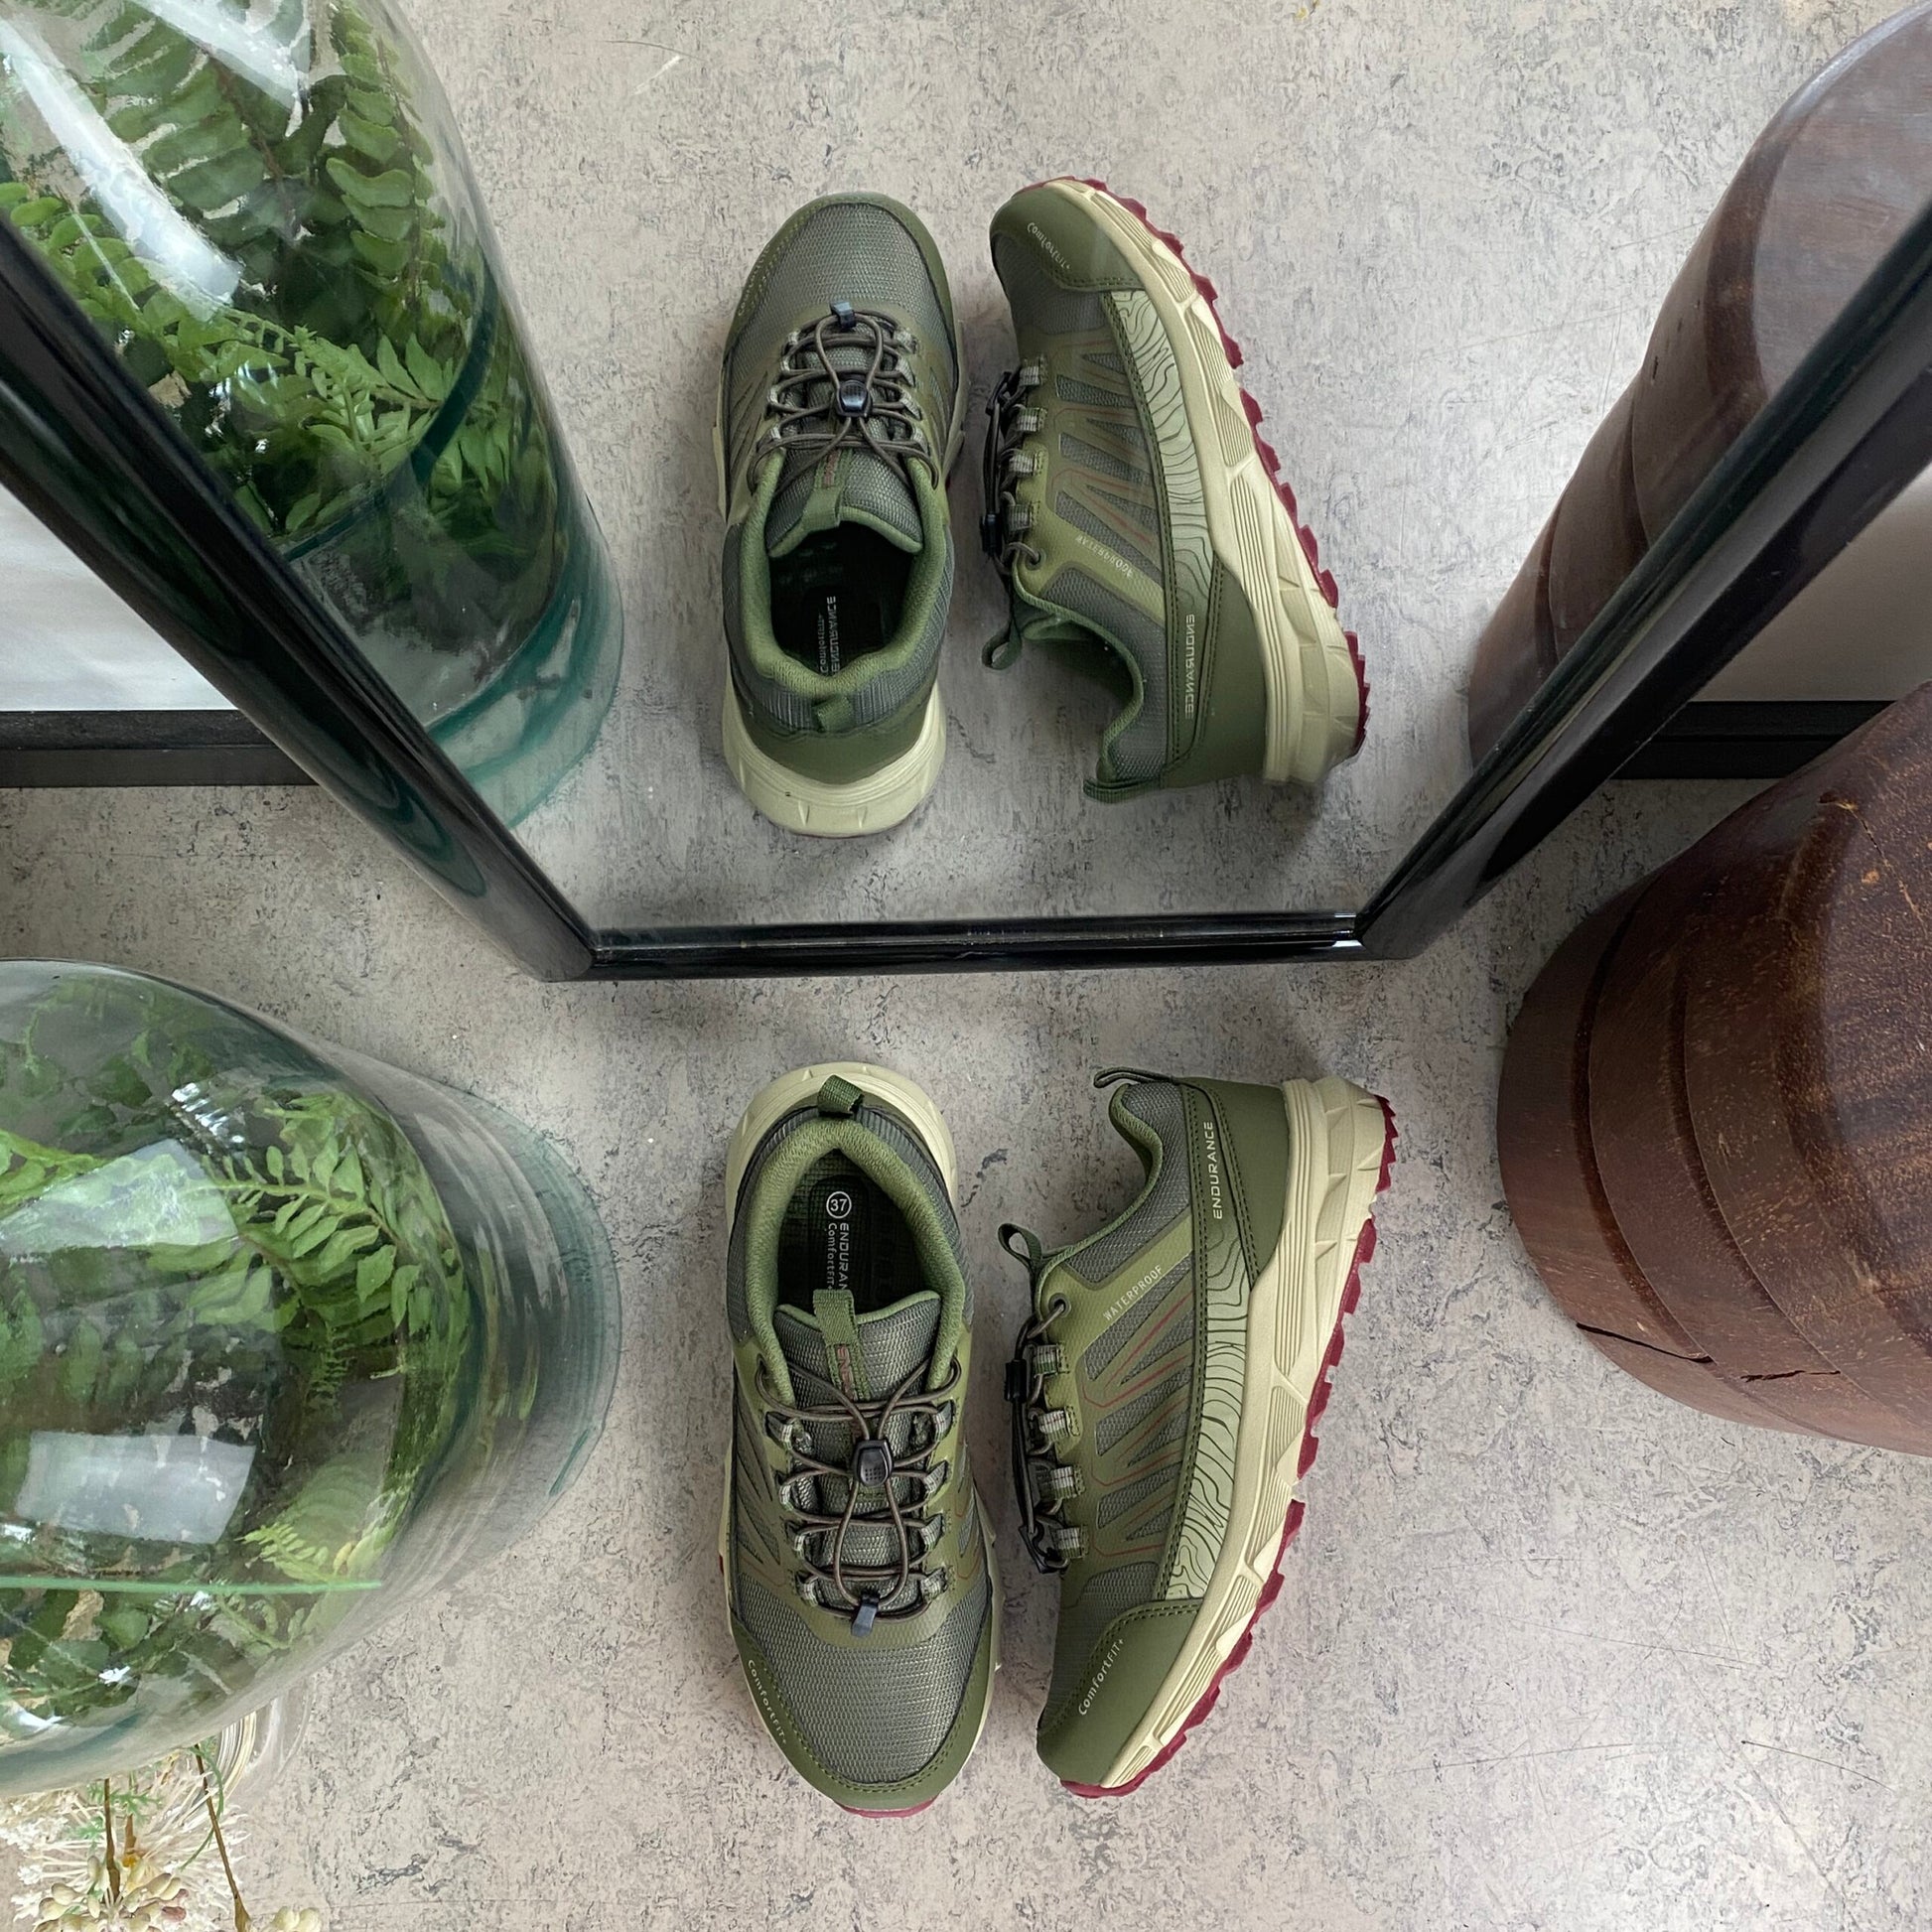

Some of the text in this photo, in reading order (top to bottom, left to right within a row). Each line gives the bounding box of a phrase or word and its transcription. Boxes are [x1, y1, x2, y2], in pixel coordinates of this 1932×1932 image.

[1203, 1121, 1223, 1220] ENDURANCE
[830, 1198, 848, 1211] 37
[838, 1222, 849, 1290] ENDURAN
[1102, 1264, 1164, 1321] WATERPROOF
